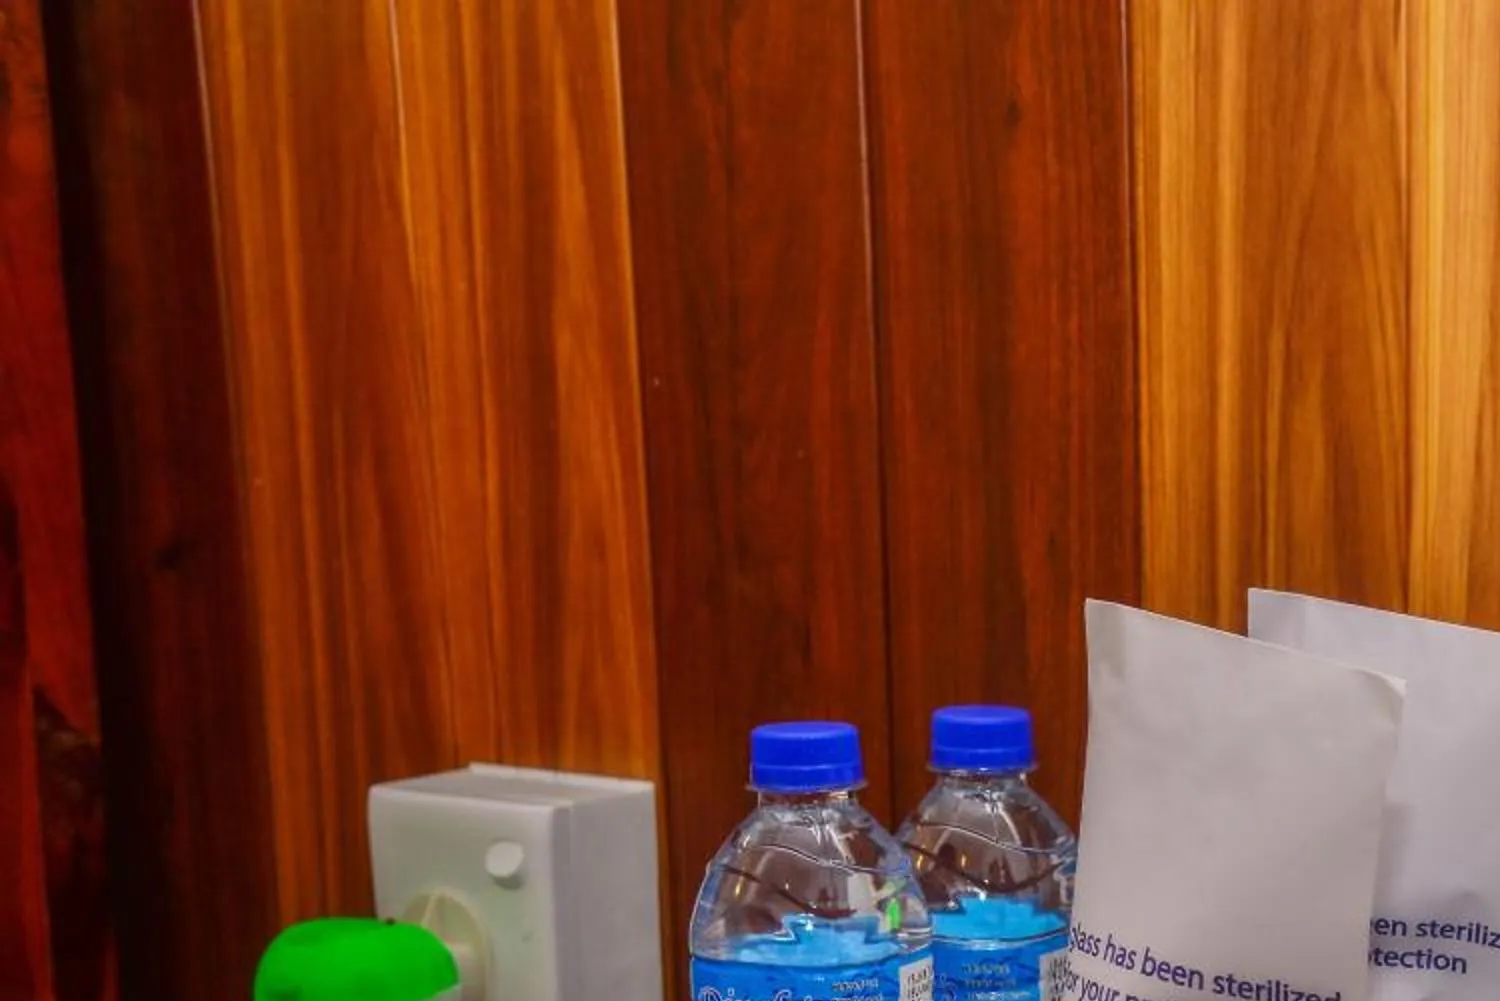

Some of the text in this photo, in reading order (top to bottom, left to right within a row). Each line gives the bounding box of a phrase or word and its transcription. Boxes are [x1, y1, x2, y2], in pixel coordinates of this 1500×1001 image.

[1370, 917, 1407, 936] en
[1103, 934, 1137, 970] has
[1140, 946, 1204, 991] been
[1368, 946, 1468, 974] tection
